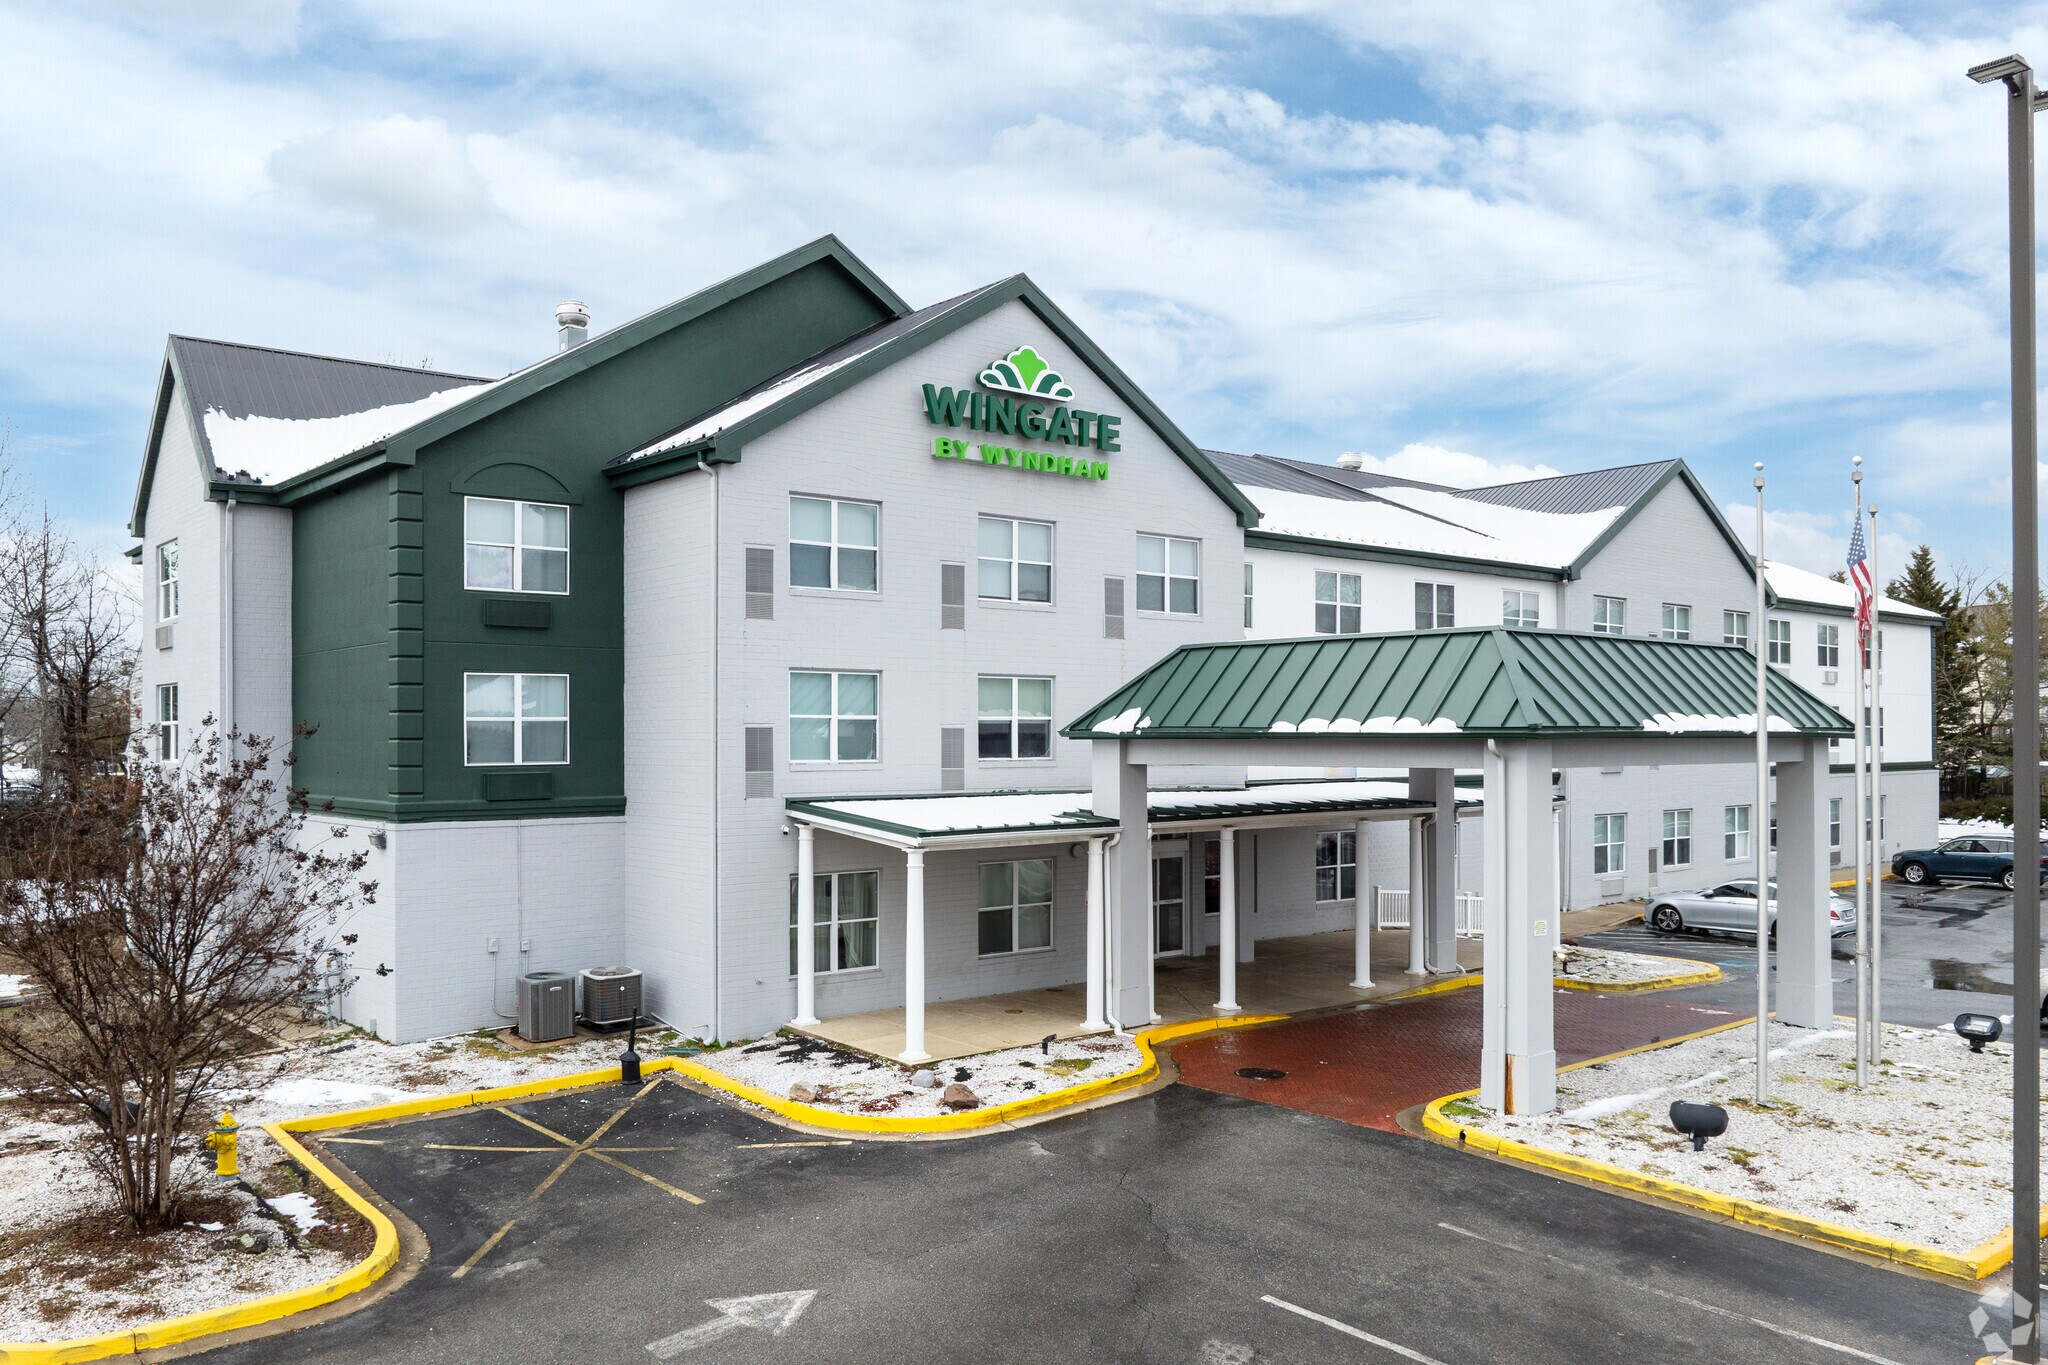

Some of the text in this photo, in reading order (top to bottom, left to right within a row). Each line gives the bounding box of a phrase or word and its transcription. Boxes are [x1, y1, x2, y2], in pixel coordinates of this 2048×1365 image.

[922, 383, 1121, 452] WINGATE
[935, 437, 1109, 480] BY WYNDHAM
